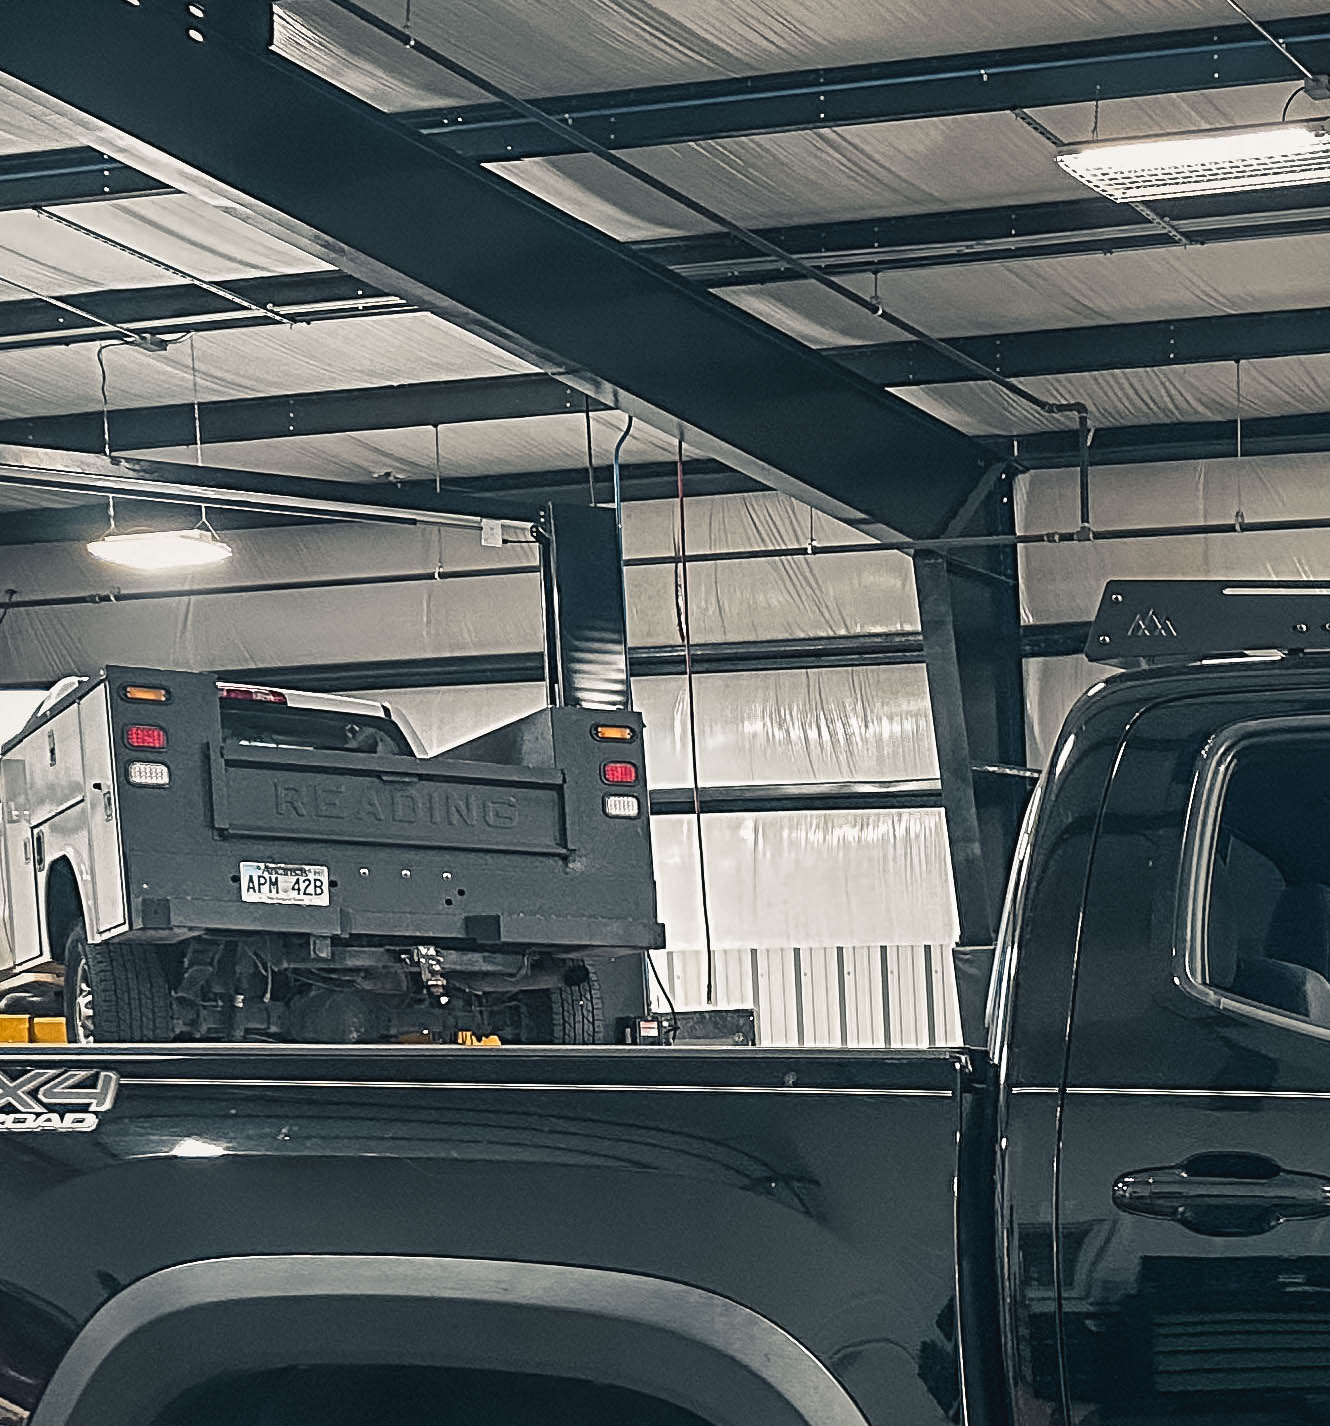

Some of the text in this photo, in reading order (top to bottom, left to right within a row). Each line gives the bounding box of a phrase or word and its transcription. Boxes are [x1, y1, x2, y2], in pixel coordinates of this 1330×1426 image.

[273, 779, 520, 829] READING
[246, 874, 324, 897] APM 42B
